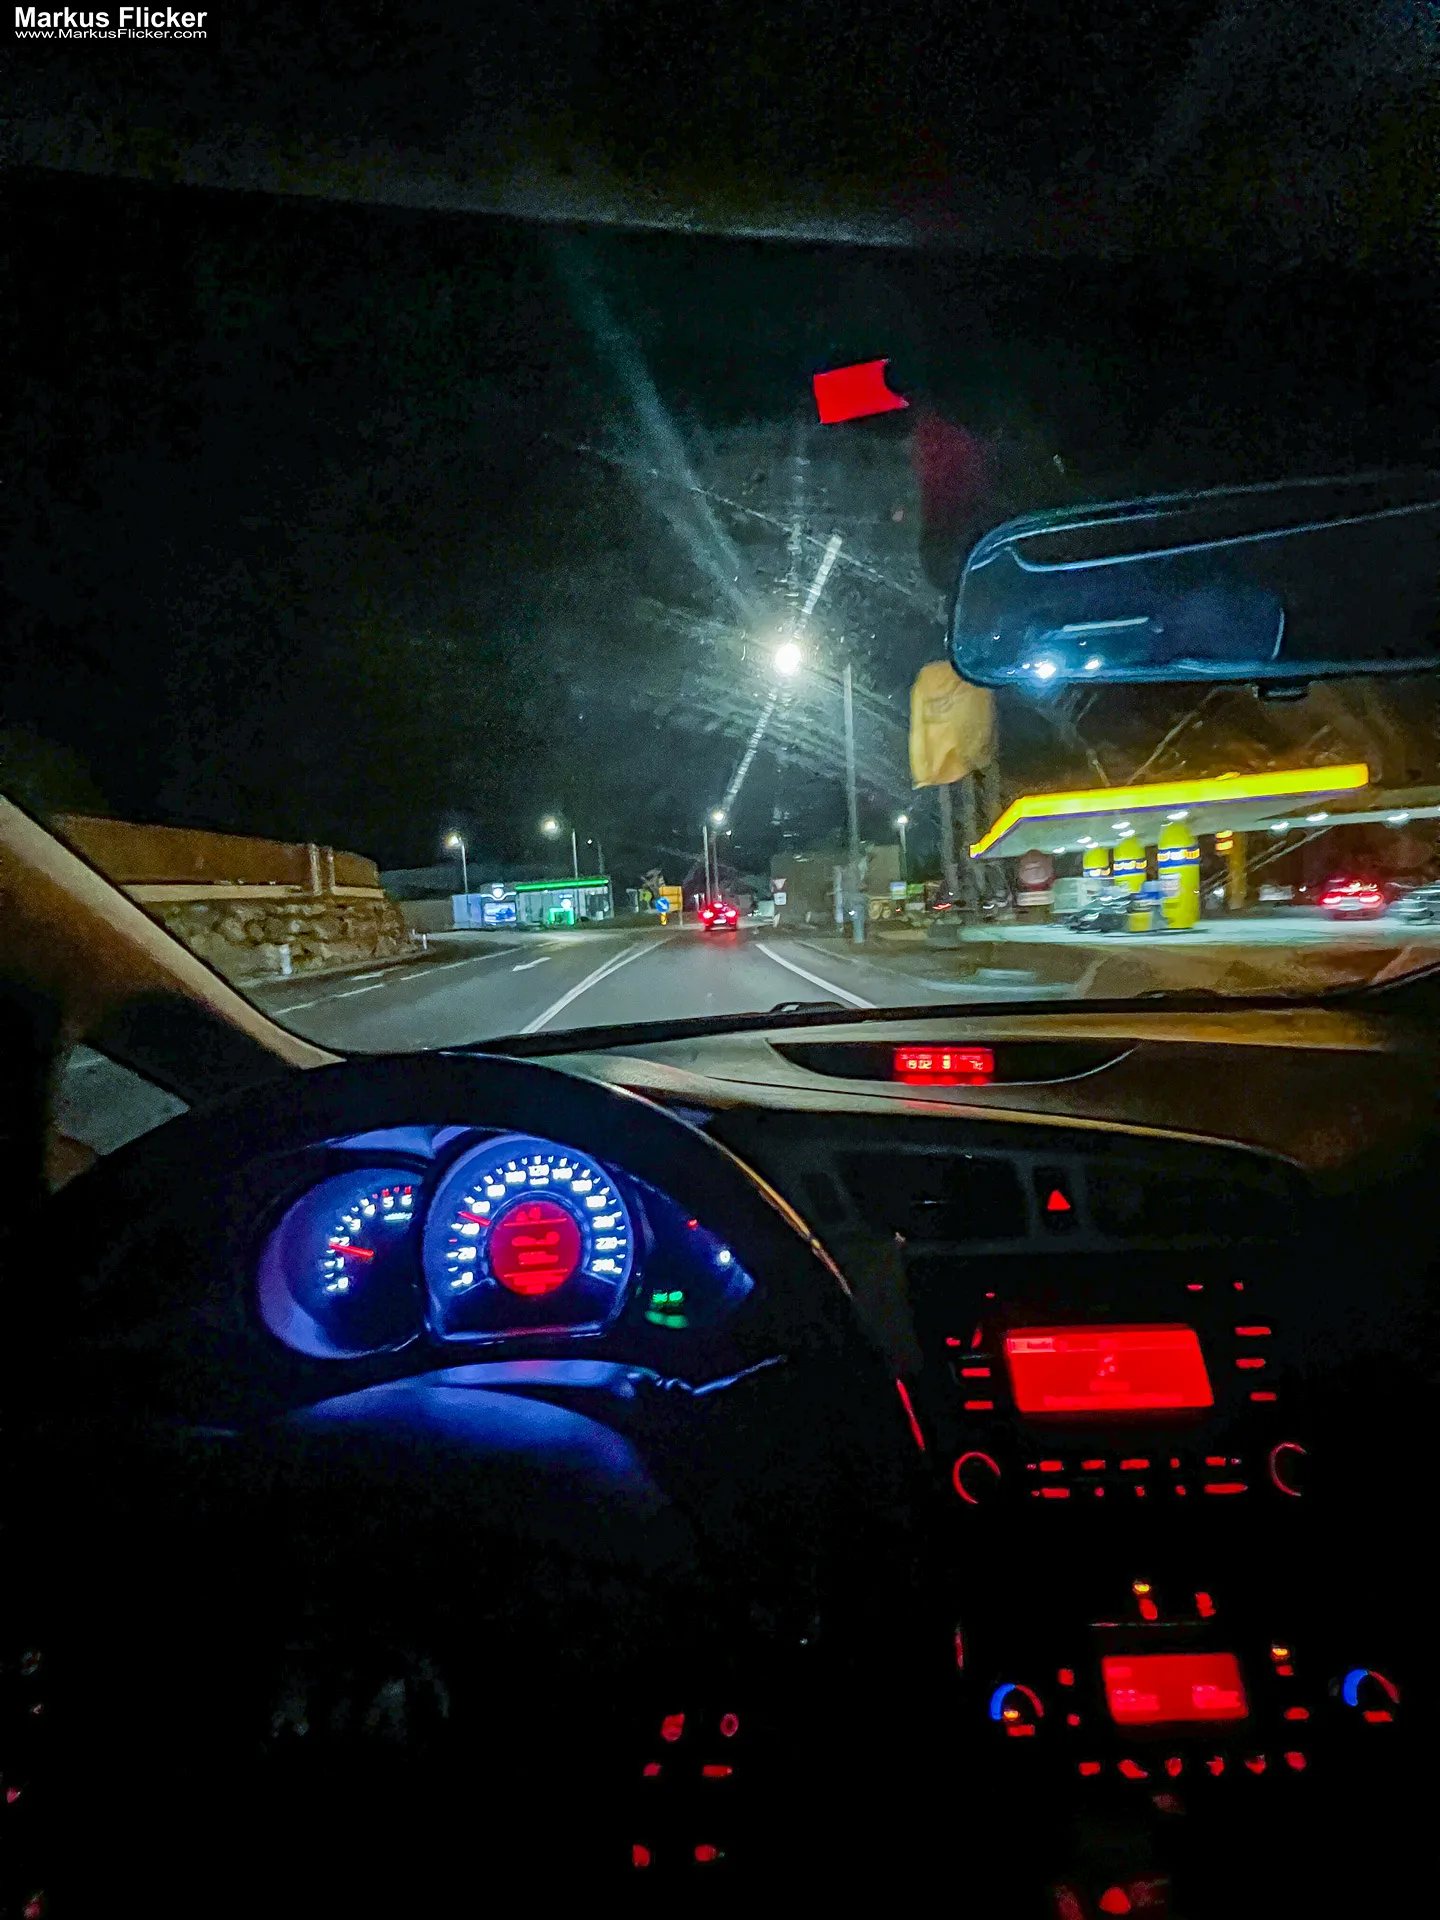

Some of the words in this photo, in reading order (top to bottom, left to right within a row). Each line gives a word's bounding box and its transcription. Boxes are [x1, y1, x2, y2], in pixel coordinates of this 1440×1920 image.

[383, 1196, 394, 1208] 5
[350, 1219, 361, 1231] 3
[339, 1236, 350, 1247] 2
